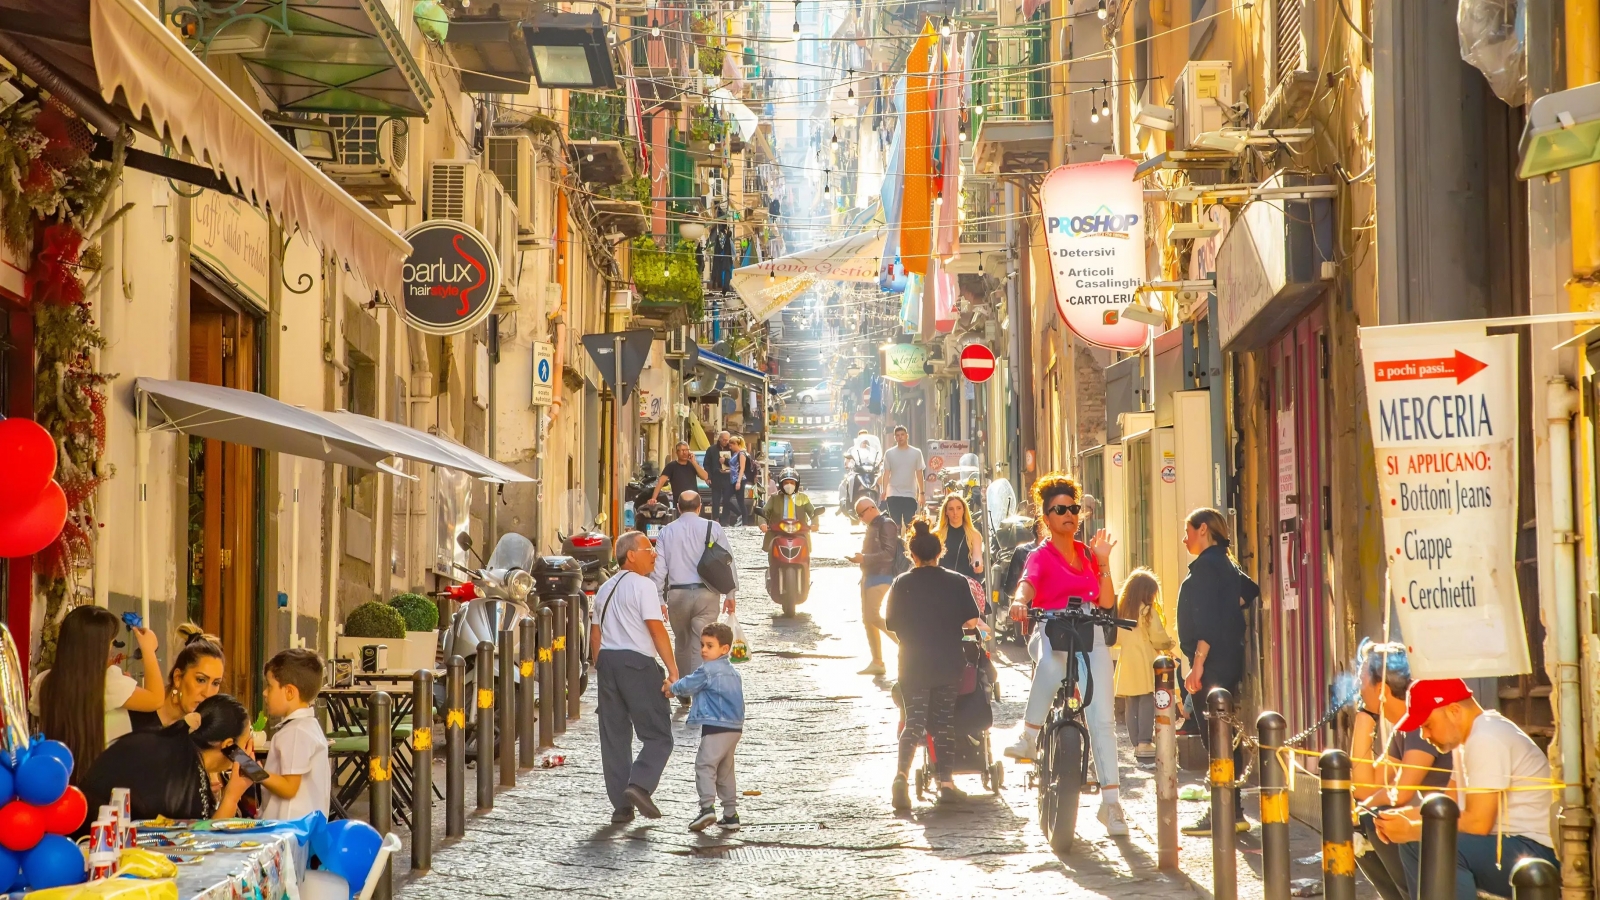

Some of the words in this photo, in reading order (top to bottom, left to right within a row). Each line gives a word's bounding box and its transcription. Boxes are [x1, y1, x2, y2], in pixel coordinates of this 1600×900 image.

[1048, 214, 1139, 237] PROSHOP
[223, 211, 241, 256] Caldo
[243, 230, 266, 278] Freddo
[1060, 248, 1115, 257] Detersivi
[402, 257, 473, 283] parlux
[814, 262, 879, 278] Gestio
[1068, 267, 1114, 277] Articoli
[410, 284, 459, 298] hairstyle
[1075, 278, 1141, 289] Casalinghi
[1377, 367, 1384, 377] a
[1387, 363, 1416, 379] pochi
[1419, 362, 1455, 378] passi...
[1379, 394, 1493, 442] MERCERIA
[1387, 455, 1399, 475] SI
[1407, 451, 1492, 474] APPLICANO:
[1400, 478, 1452, 512] Bottoni
[1455, 480, 1492, 515] Jeans
[1404, 529, 1452, 570] Ciappe
[1408, 575, 1477, 610] Cerchietti
